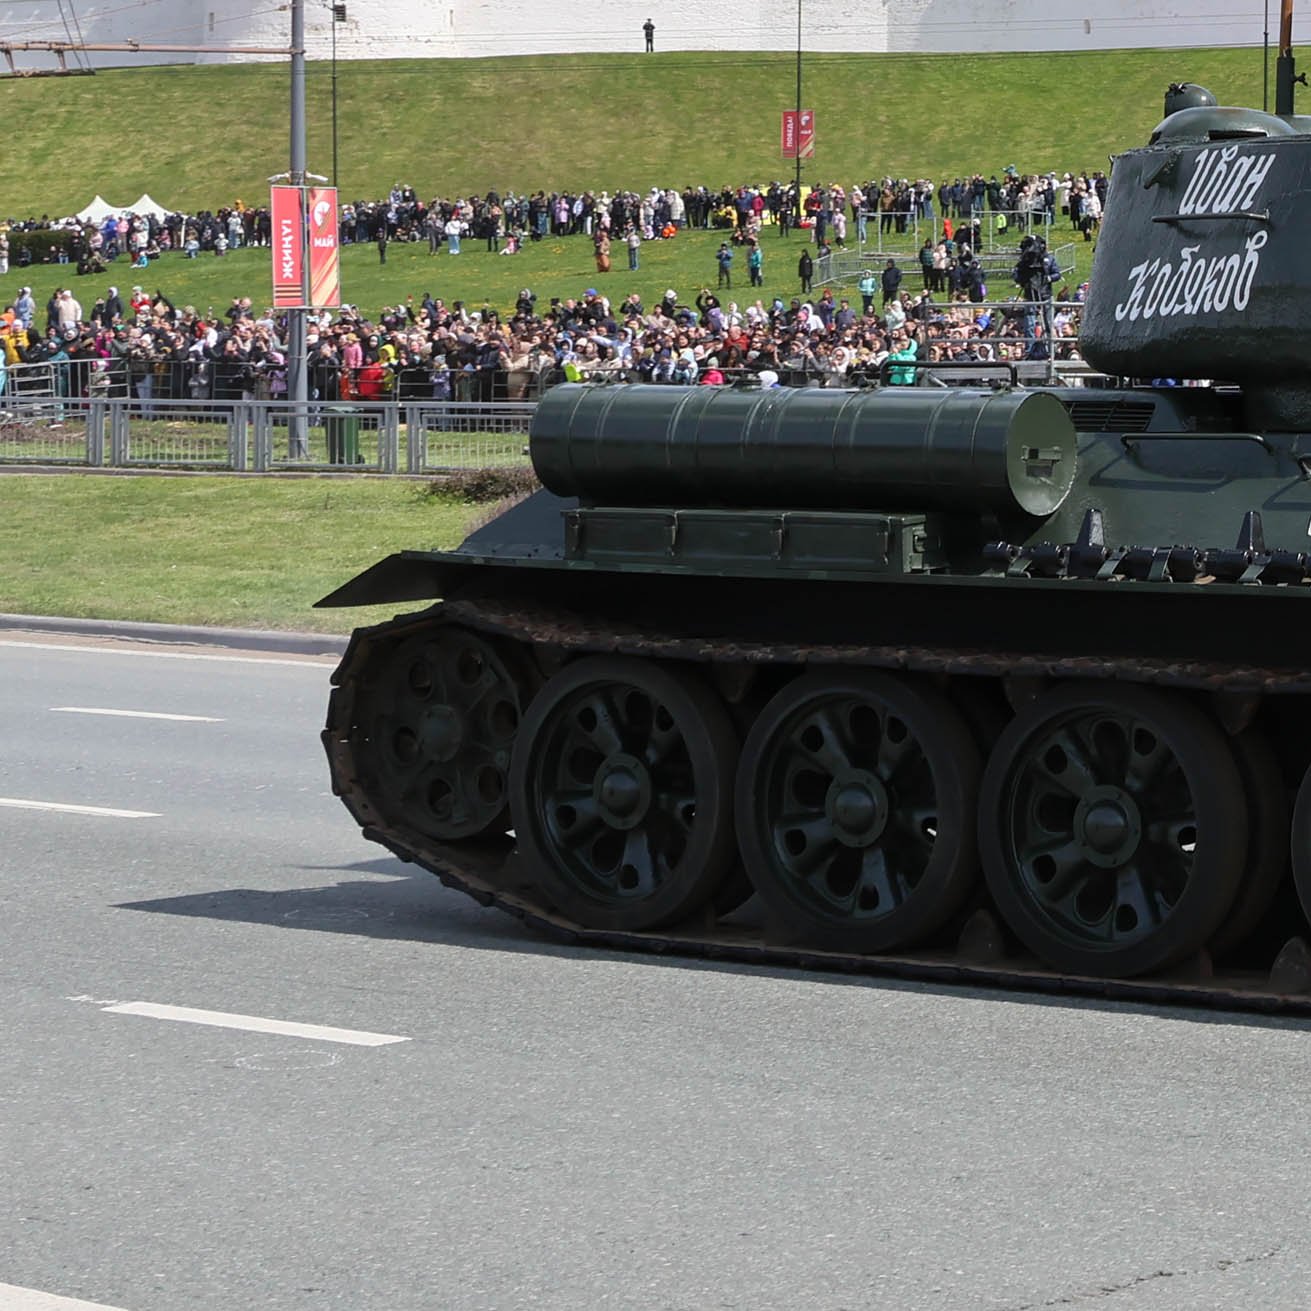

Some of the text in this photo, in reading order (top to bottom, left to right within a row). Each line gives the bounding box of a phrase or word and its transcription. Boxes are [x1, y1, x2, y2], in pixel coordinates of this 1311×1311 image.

[1178, 144, 1277, 215] Иван
[313, 234, 335, 248] МАЙ
[1114, 229, 1269, 322] Кобяков
